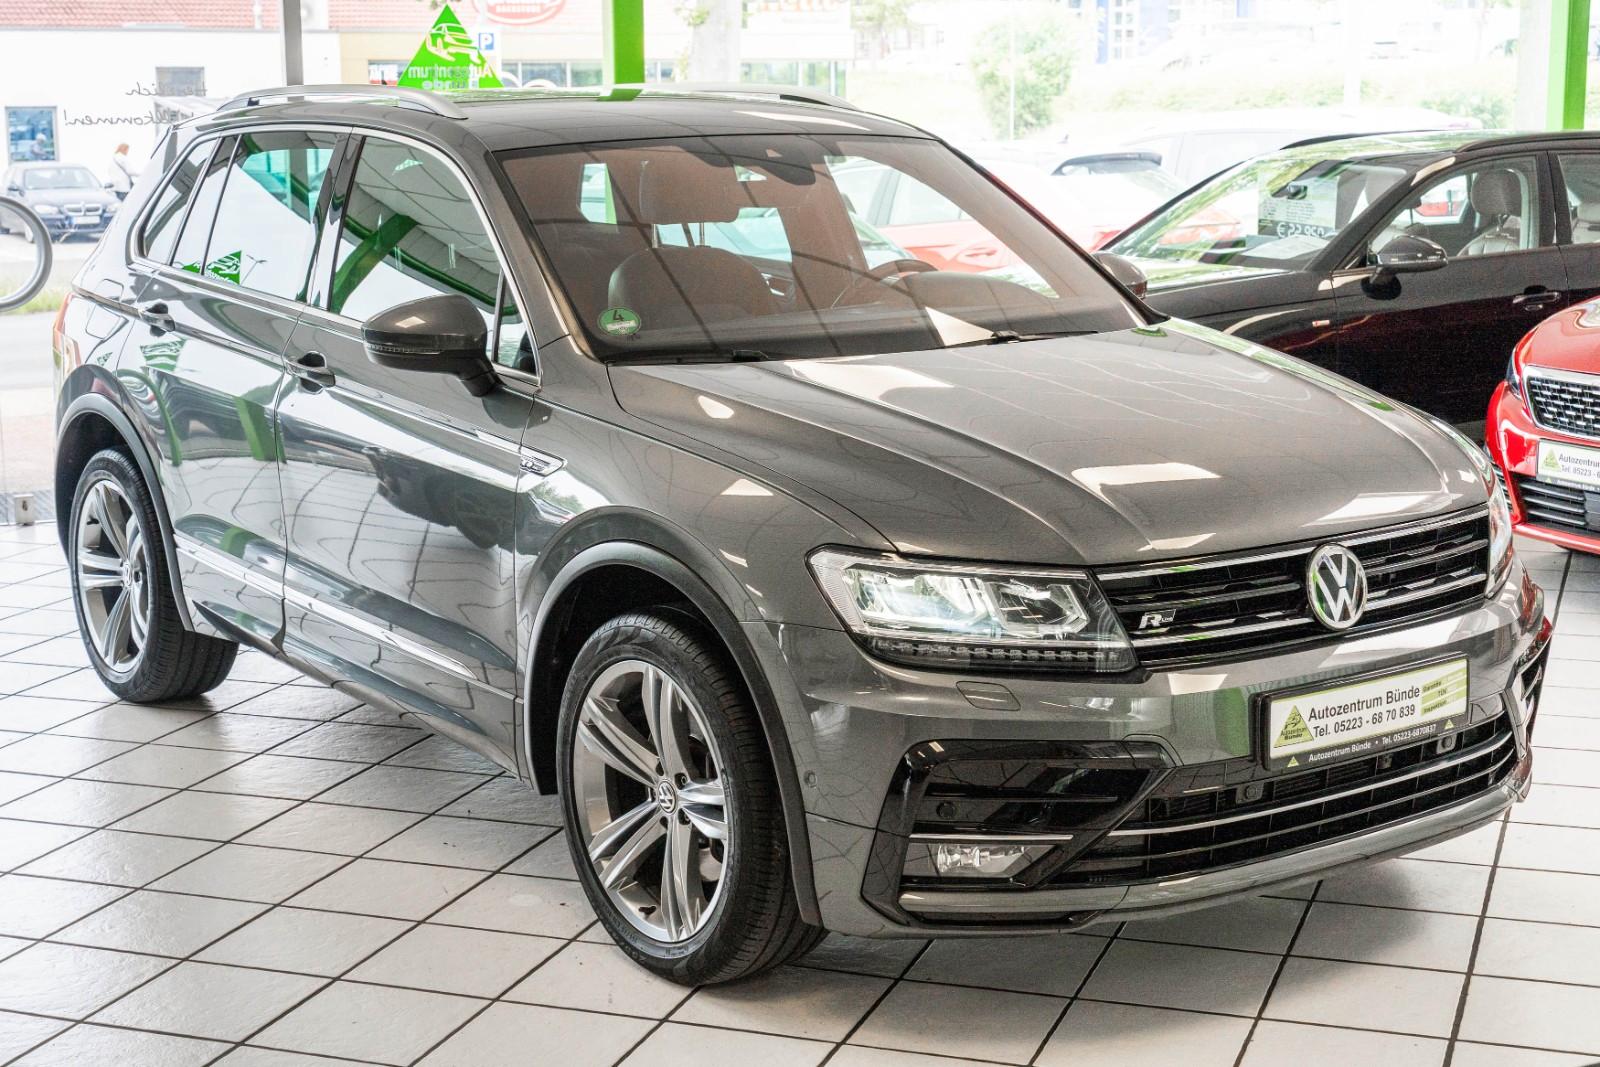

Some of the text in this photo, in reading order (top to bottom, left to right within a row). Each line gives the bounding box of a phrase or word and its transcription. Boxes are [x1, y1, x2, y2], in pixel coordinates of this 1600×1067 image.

[480, 33, 493, 50] P
[1308, 685, 1420, 722] Autozentrum Bünde
[1313, 723, 1331, 738] Tel.
[1334, 716, 1363, 734] 05223
[1372, 711, 1383, 725] 68
[1386, 708, 1397, 722] 70
[1399, 704, 1416, 718] 839
[1308, 747, 1351, 763] Autozentrum
[1351, 740, 1372, 753] Bünde
